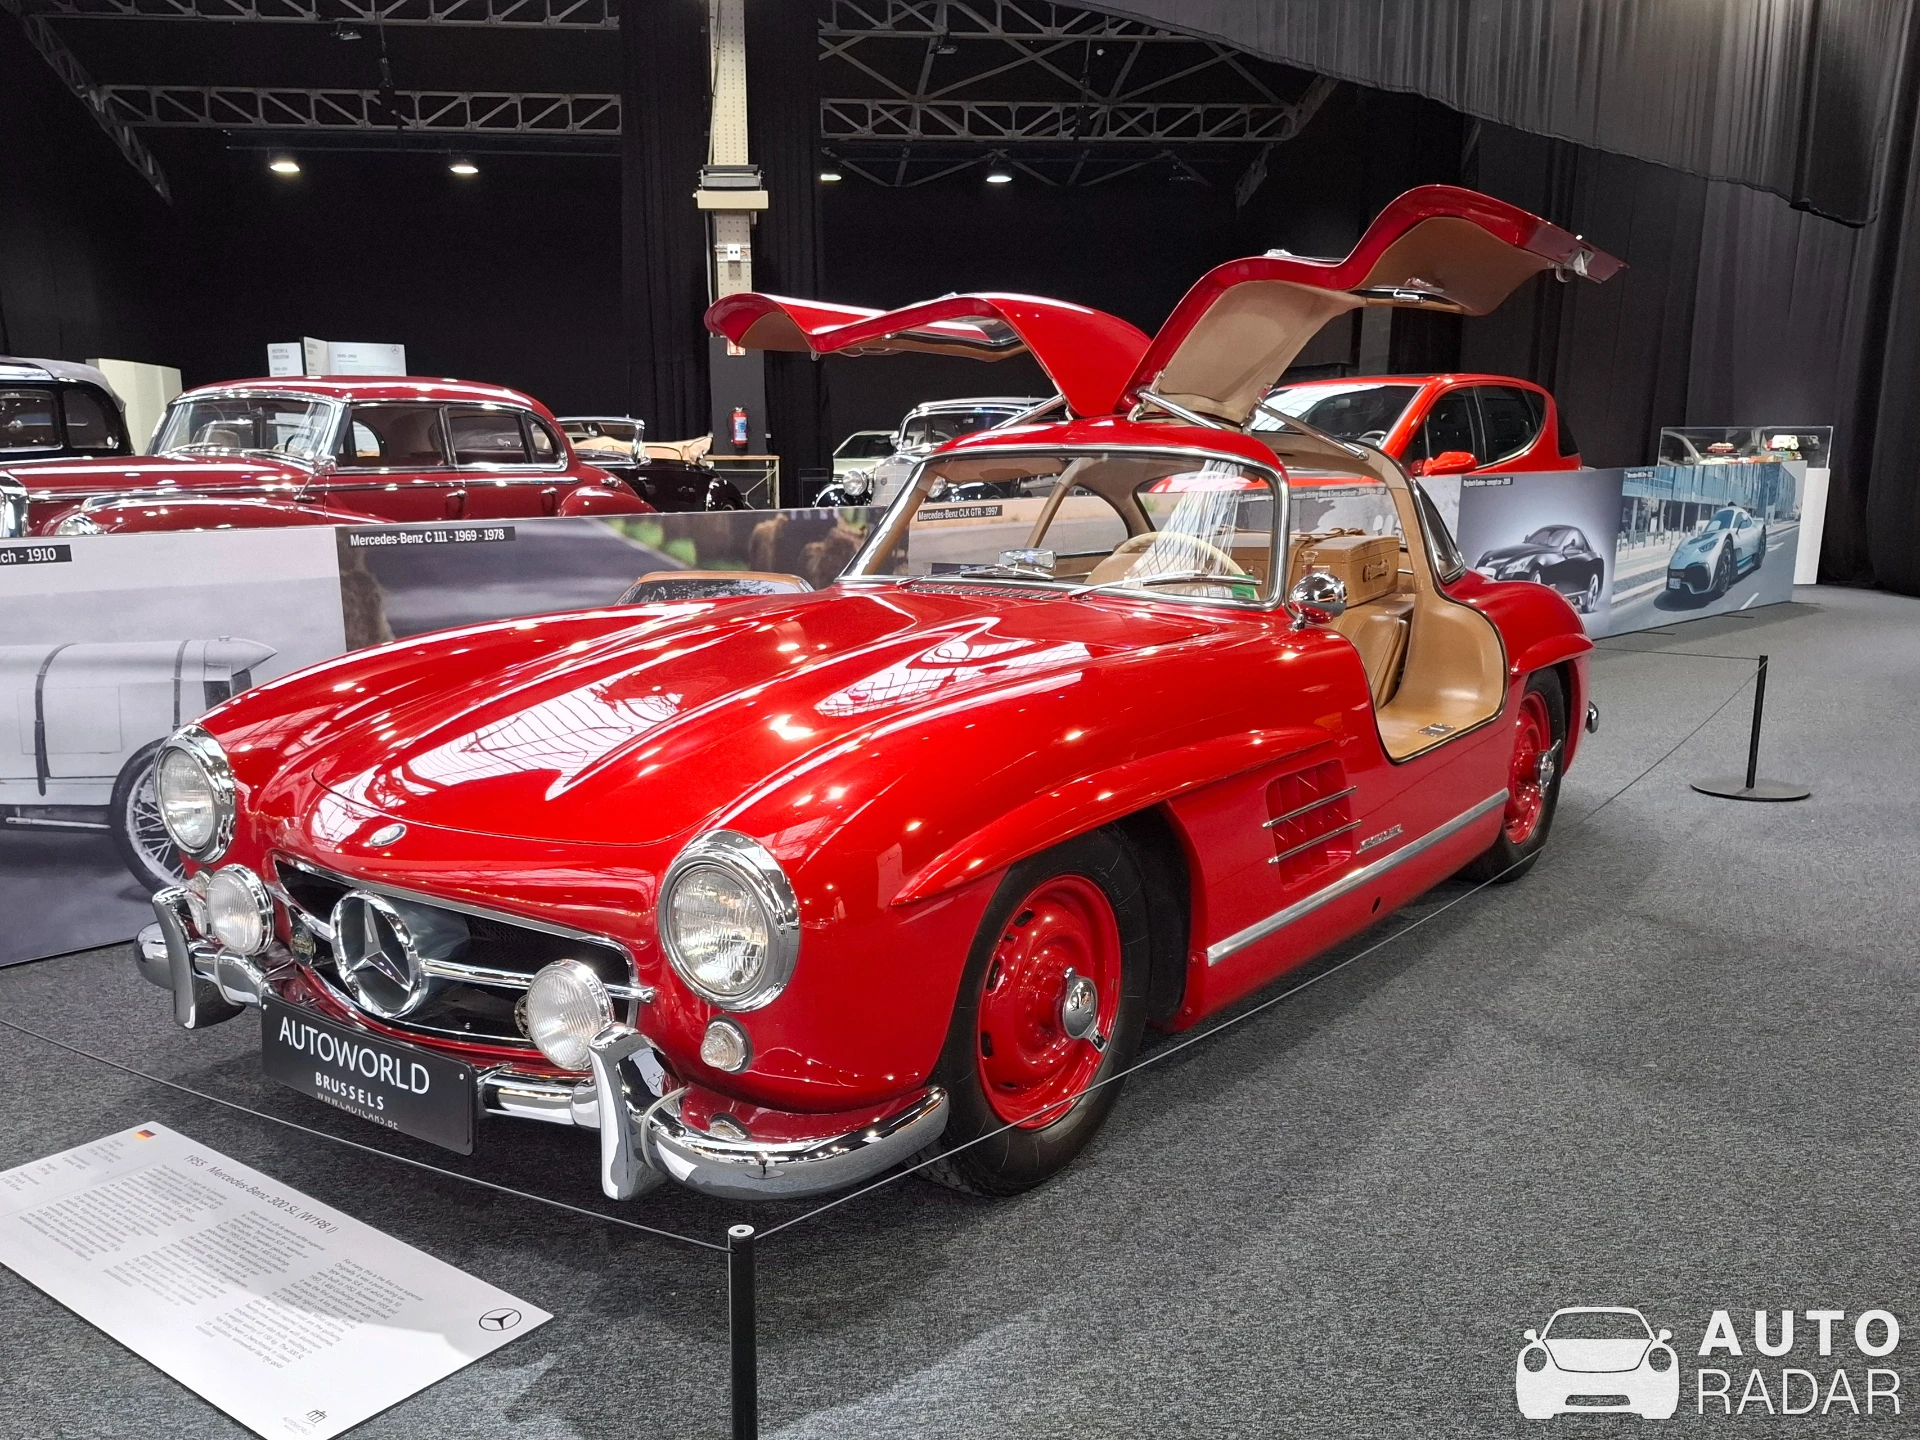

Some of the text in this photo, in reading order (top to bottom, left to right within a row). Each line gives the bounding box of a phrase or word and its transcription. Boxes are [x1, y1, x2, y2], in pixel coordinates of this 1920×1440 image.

[918, 509, 958, 520] Mercedes-Benz
[959, 508, 970, 518] CLK
[970, 508, 982, 517] GTR
[985, 506, 998, 516] 1997
[350, 532, 424, 546] Mercedes-Benz
[425, 532, 433, 543] C
[434, 531, 449, 543] 111
[454, 530, 478, 542] 1969
[484, 528, 505, 540] 1978
[26, 547, 57, 562] 1910
[279, 1016, 430, 1095] AUTOWORLD
[315, 1071, 384, 1111] BRUSSELS
[184, 1154, 208, 1166] 1955
[206, 1166, 270, 1200] Mercedes-Benz
[268, 1196, 290, 1208] 300
[284, 1206, 300, 1215] SL
[294, 1212, 332, 1229] (W198
